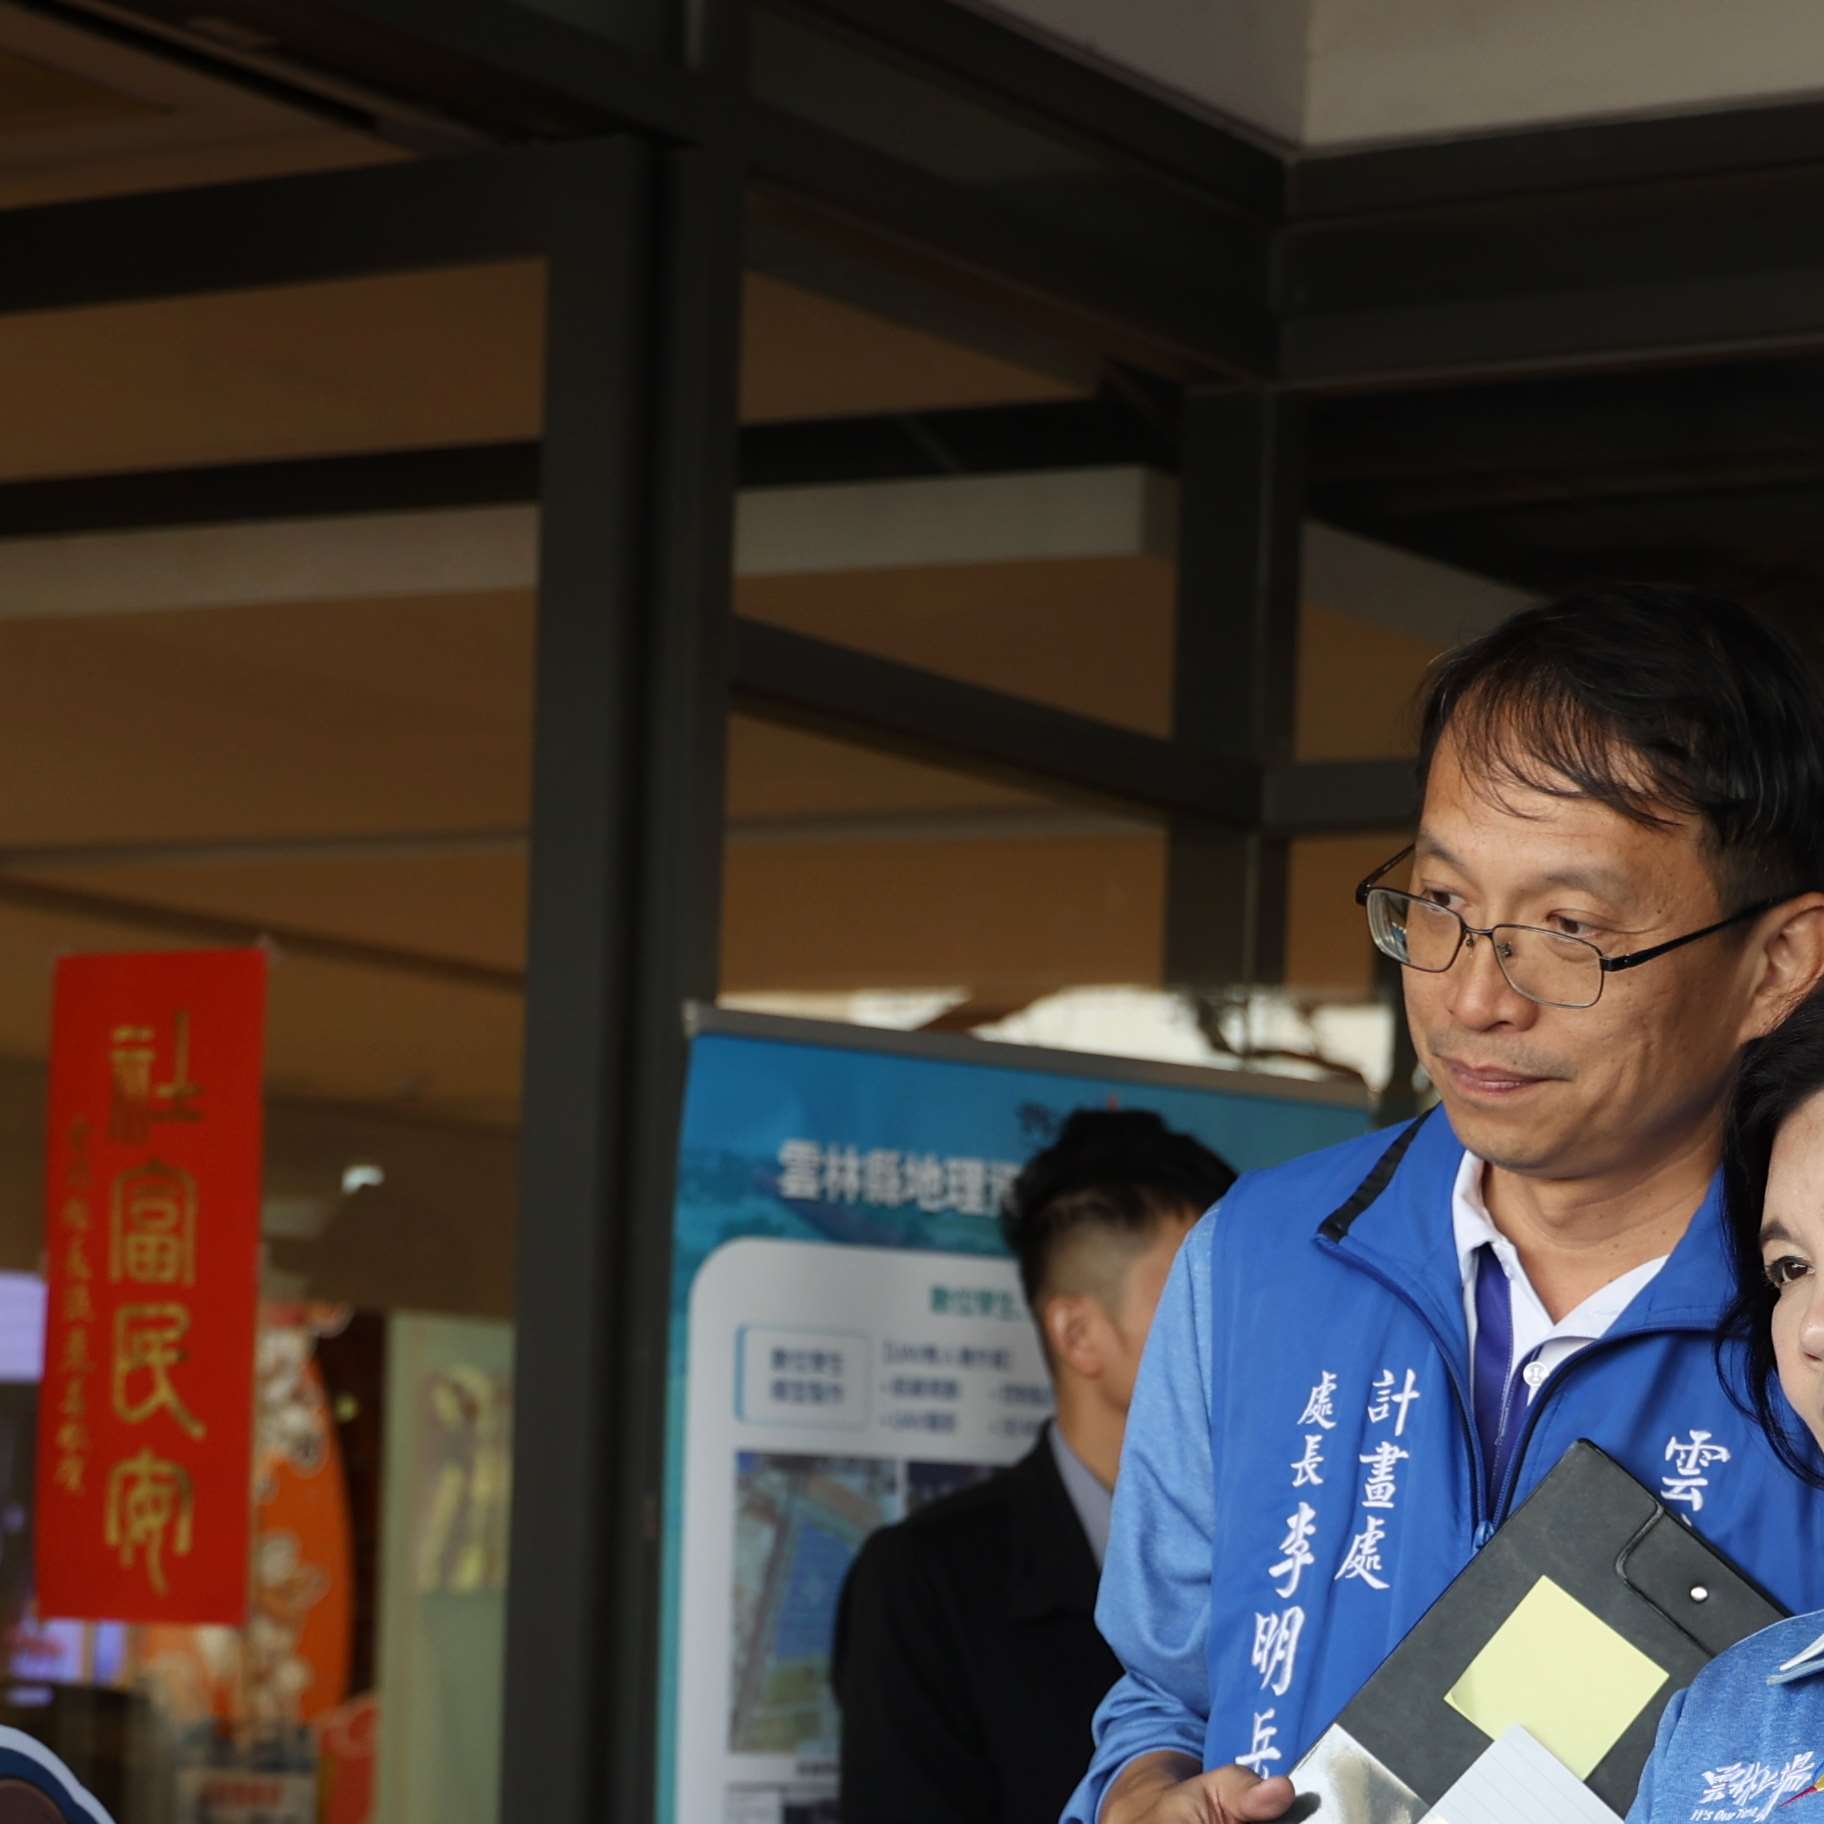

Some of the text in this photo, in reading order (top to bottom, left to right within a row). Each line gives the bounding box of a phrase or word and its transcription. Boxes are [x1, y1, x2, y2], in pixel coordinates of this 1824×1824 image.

[1334, 1368, 1421, 1592] 計畫處
[1660, 1427, 1732, 1528] 雲
